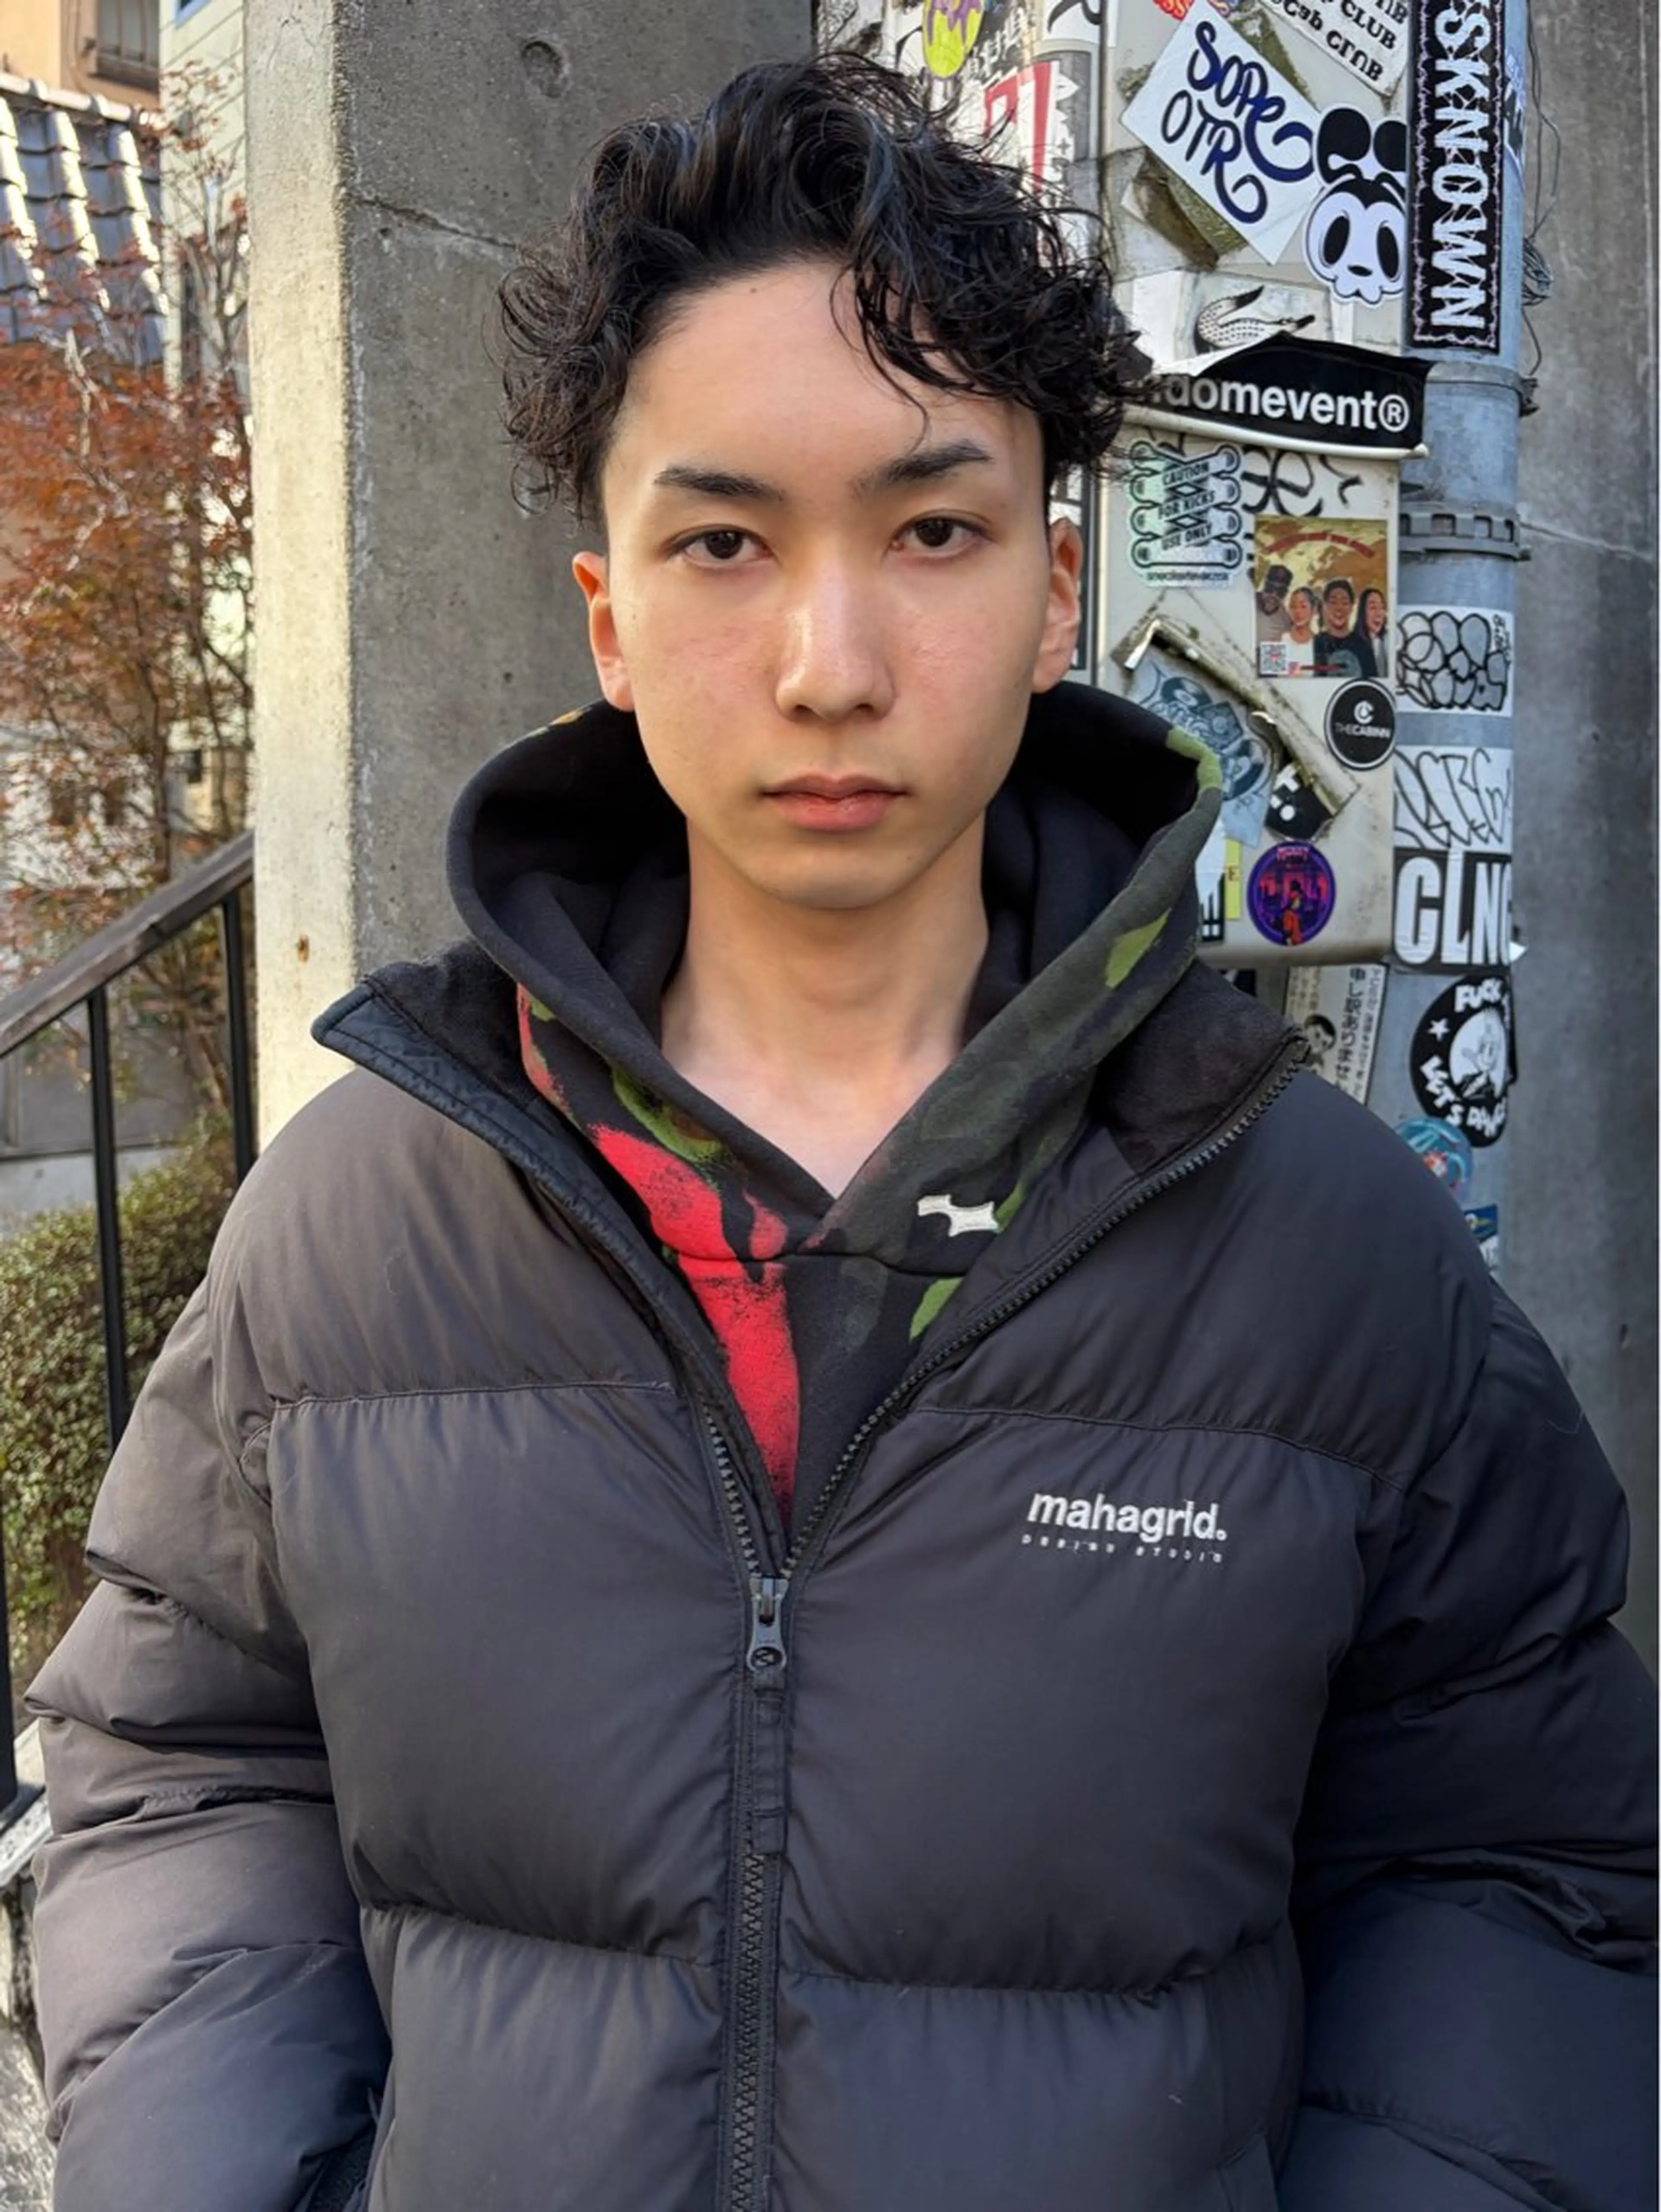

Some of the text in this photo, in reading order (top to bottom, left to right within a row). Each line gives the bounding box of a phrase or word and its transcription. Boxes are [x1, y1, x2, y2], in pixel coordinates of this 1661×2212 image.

[1340, 0, 1397, 49] CLUB
[1161, 90, 1267, 224] OTR
[1431, 0, 1491, 328] SKNOWN
[1162, 462, 1209, 486] CAUTION
[1158, 500, 1180, 520] FOR
[1161, 523, 1212, 551] USE ONLY
